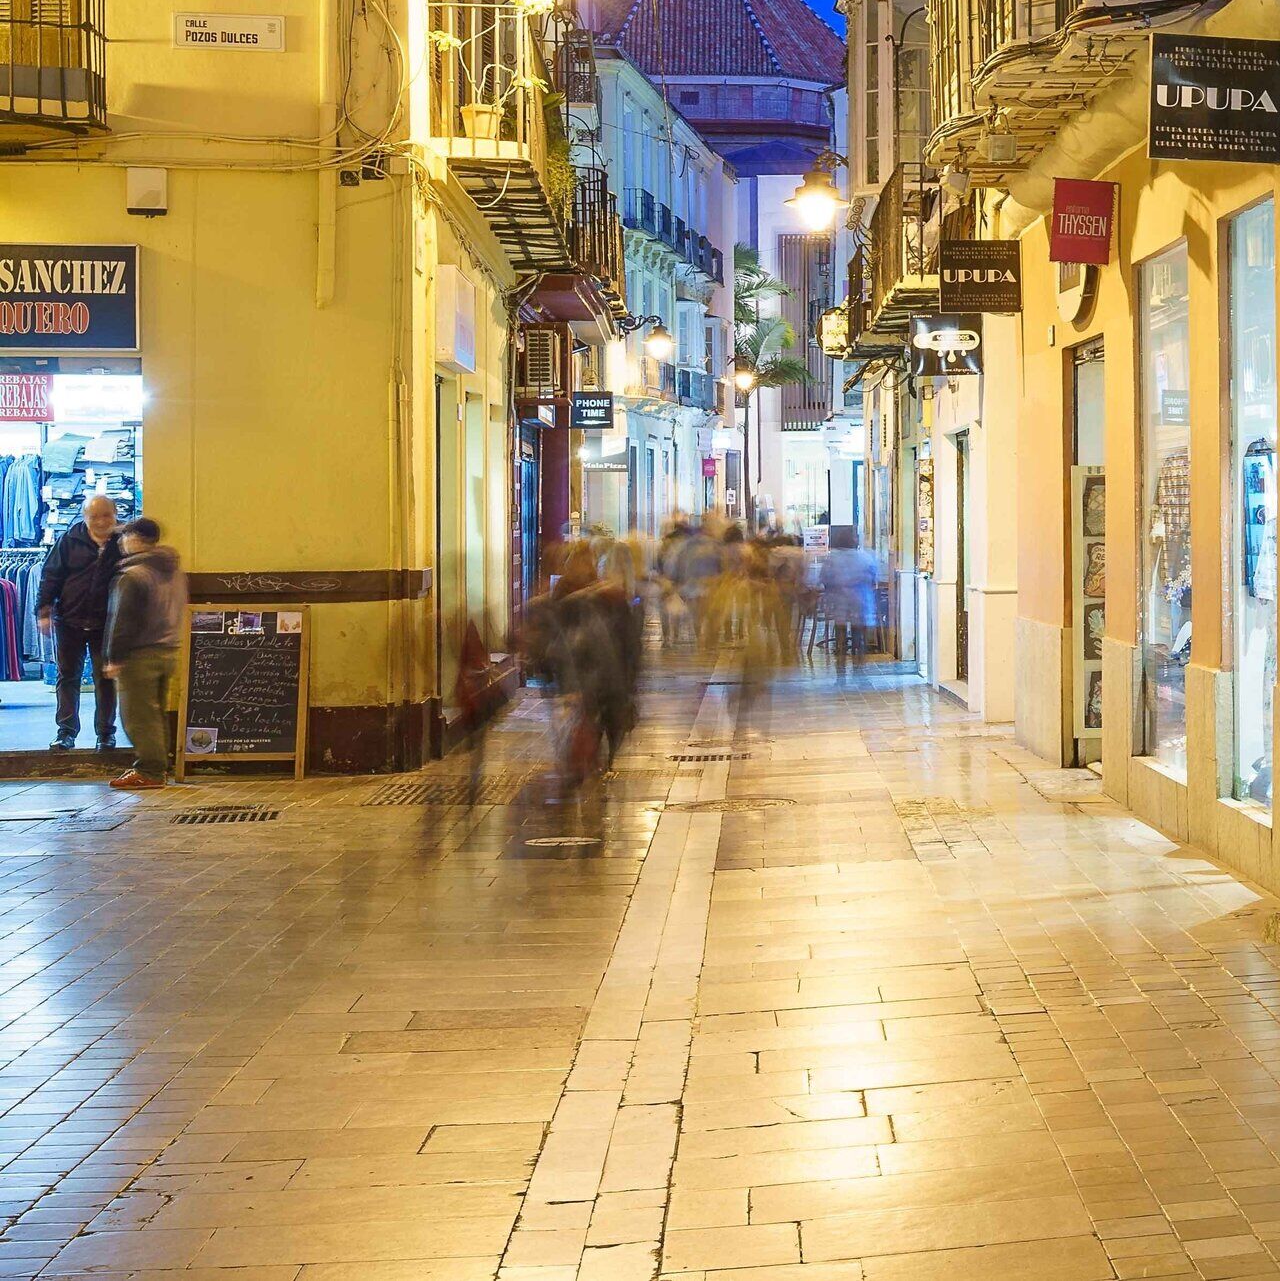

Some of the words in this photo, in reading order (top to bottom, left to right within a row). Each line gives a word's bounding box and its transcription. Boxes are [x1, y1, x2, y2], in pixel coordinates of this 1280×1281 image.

[185, 20, 208, 28] CALLE
[1156, 84, 1279, 113] UPUPA
[1057, 213, 1108, 237] THYSSEN
[0, 259, 127, 294] SANCHEZ
[943, 269, 1017, 283] UPUPA
[576, 399, 610, 408] PHONE
[580, 409, 606, 417] TIME
